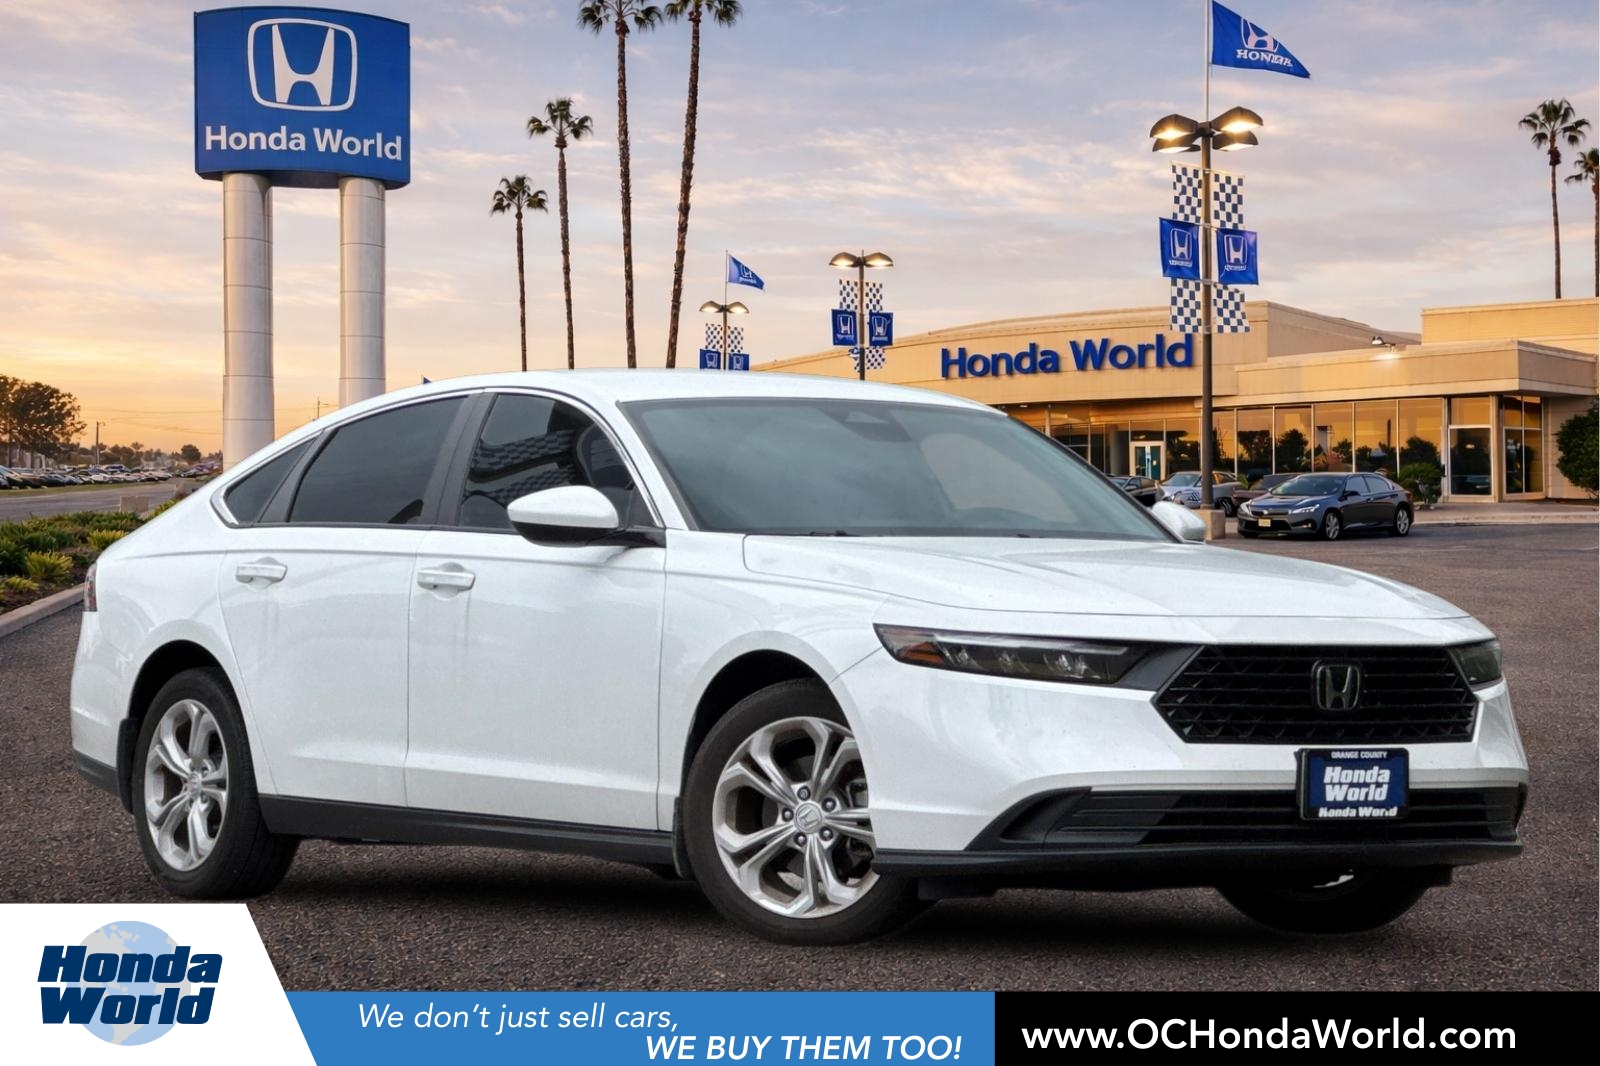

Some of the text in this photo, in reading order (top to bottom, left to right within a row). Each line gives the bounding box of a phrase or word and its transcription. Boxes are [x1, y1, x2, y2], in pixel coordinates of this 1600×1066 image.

[205, 125, 402, 161] Honda World
[941, 333, 1193, 379] Honda World
[1331, 751, 1388, 759] ORANGE COUNTY
[1323, 766, 1390, 783] Honda
[1325, 784, 1388, 801] World
[1318, 807, 1356, 818] Honda
